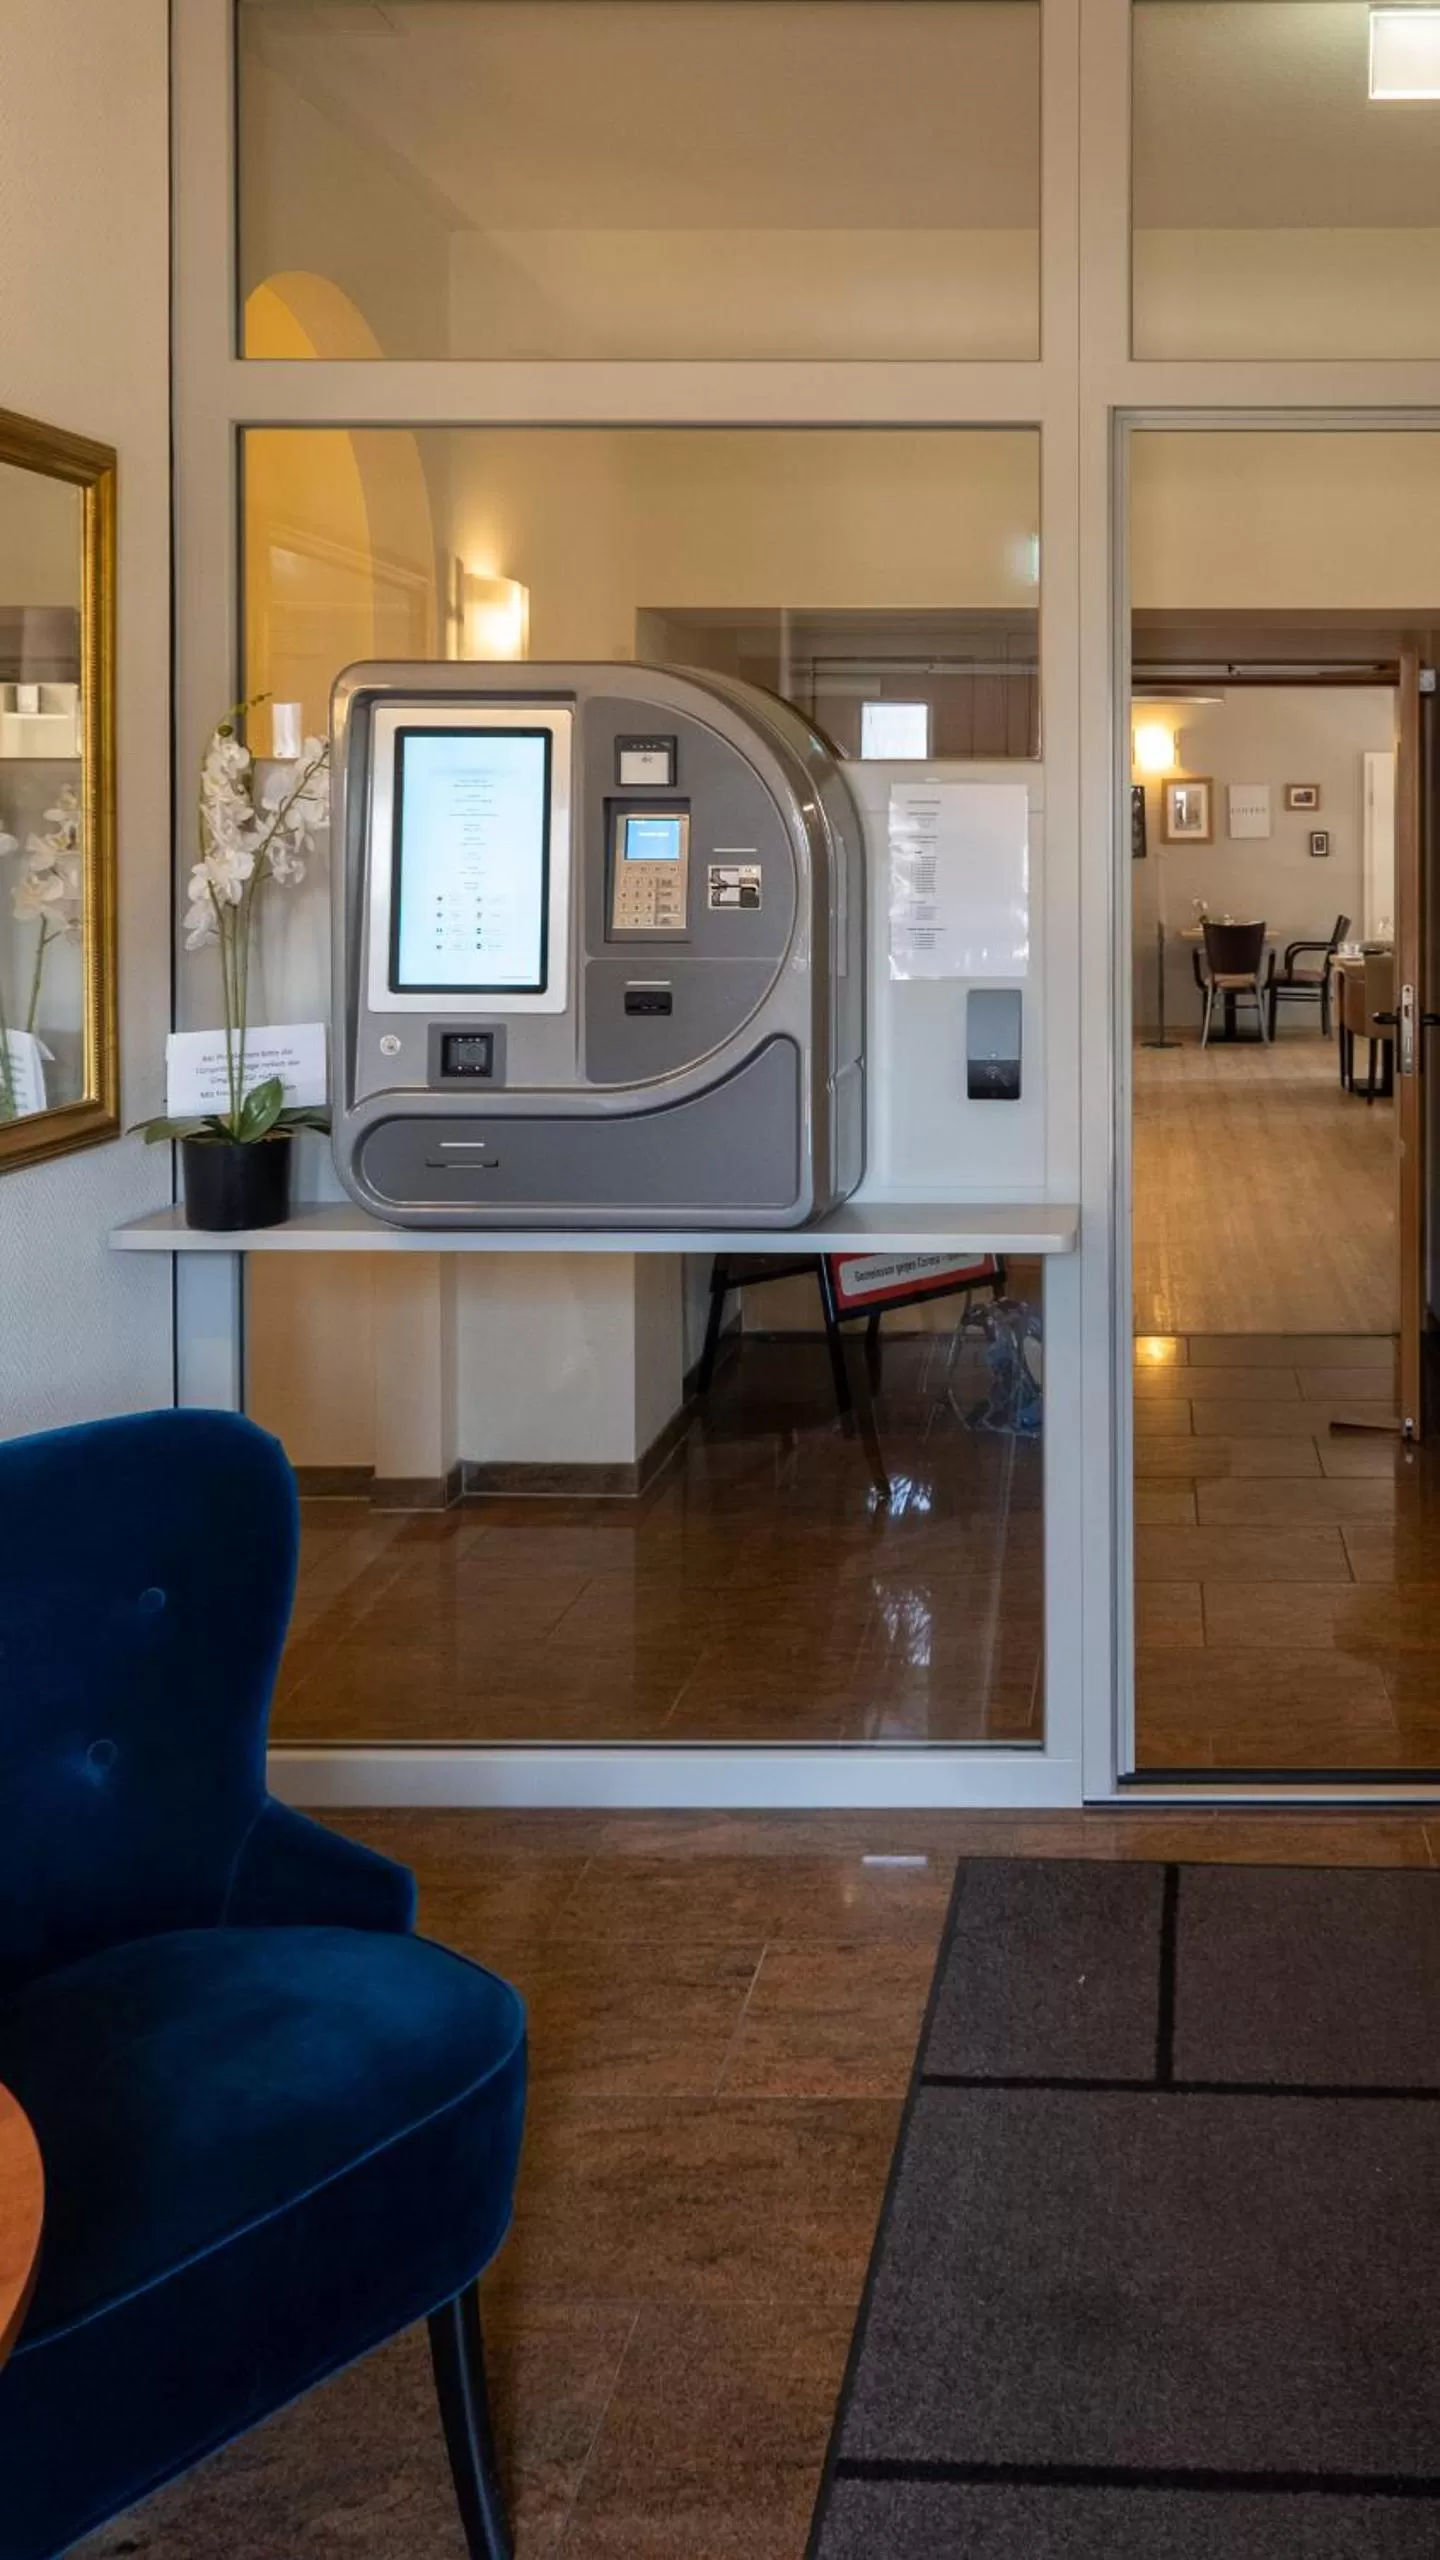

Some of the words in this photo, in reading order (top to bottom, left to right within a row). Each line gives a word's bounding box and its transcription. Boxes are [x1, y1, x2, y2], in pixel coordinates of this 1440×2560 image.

[854, 1265, 895, 1282] Gemeinsam
[895, 1260, 917, 1277] gegen
[917, 1255, 941, 1269] Corona
